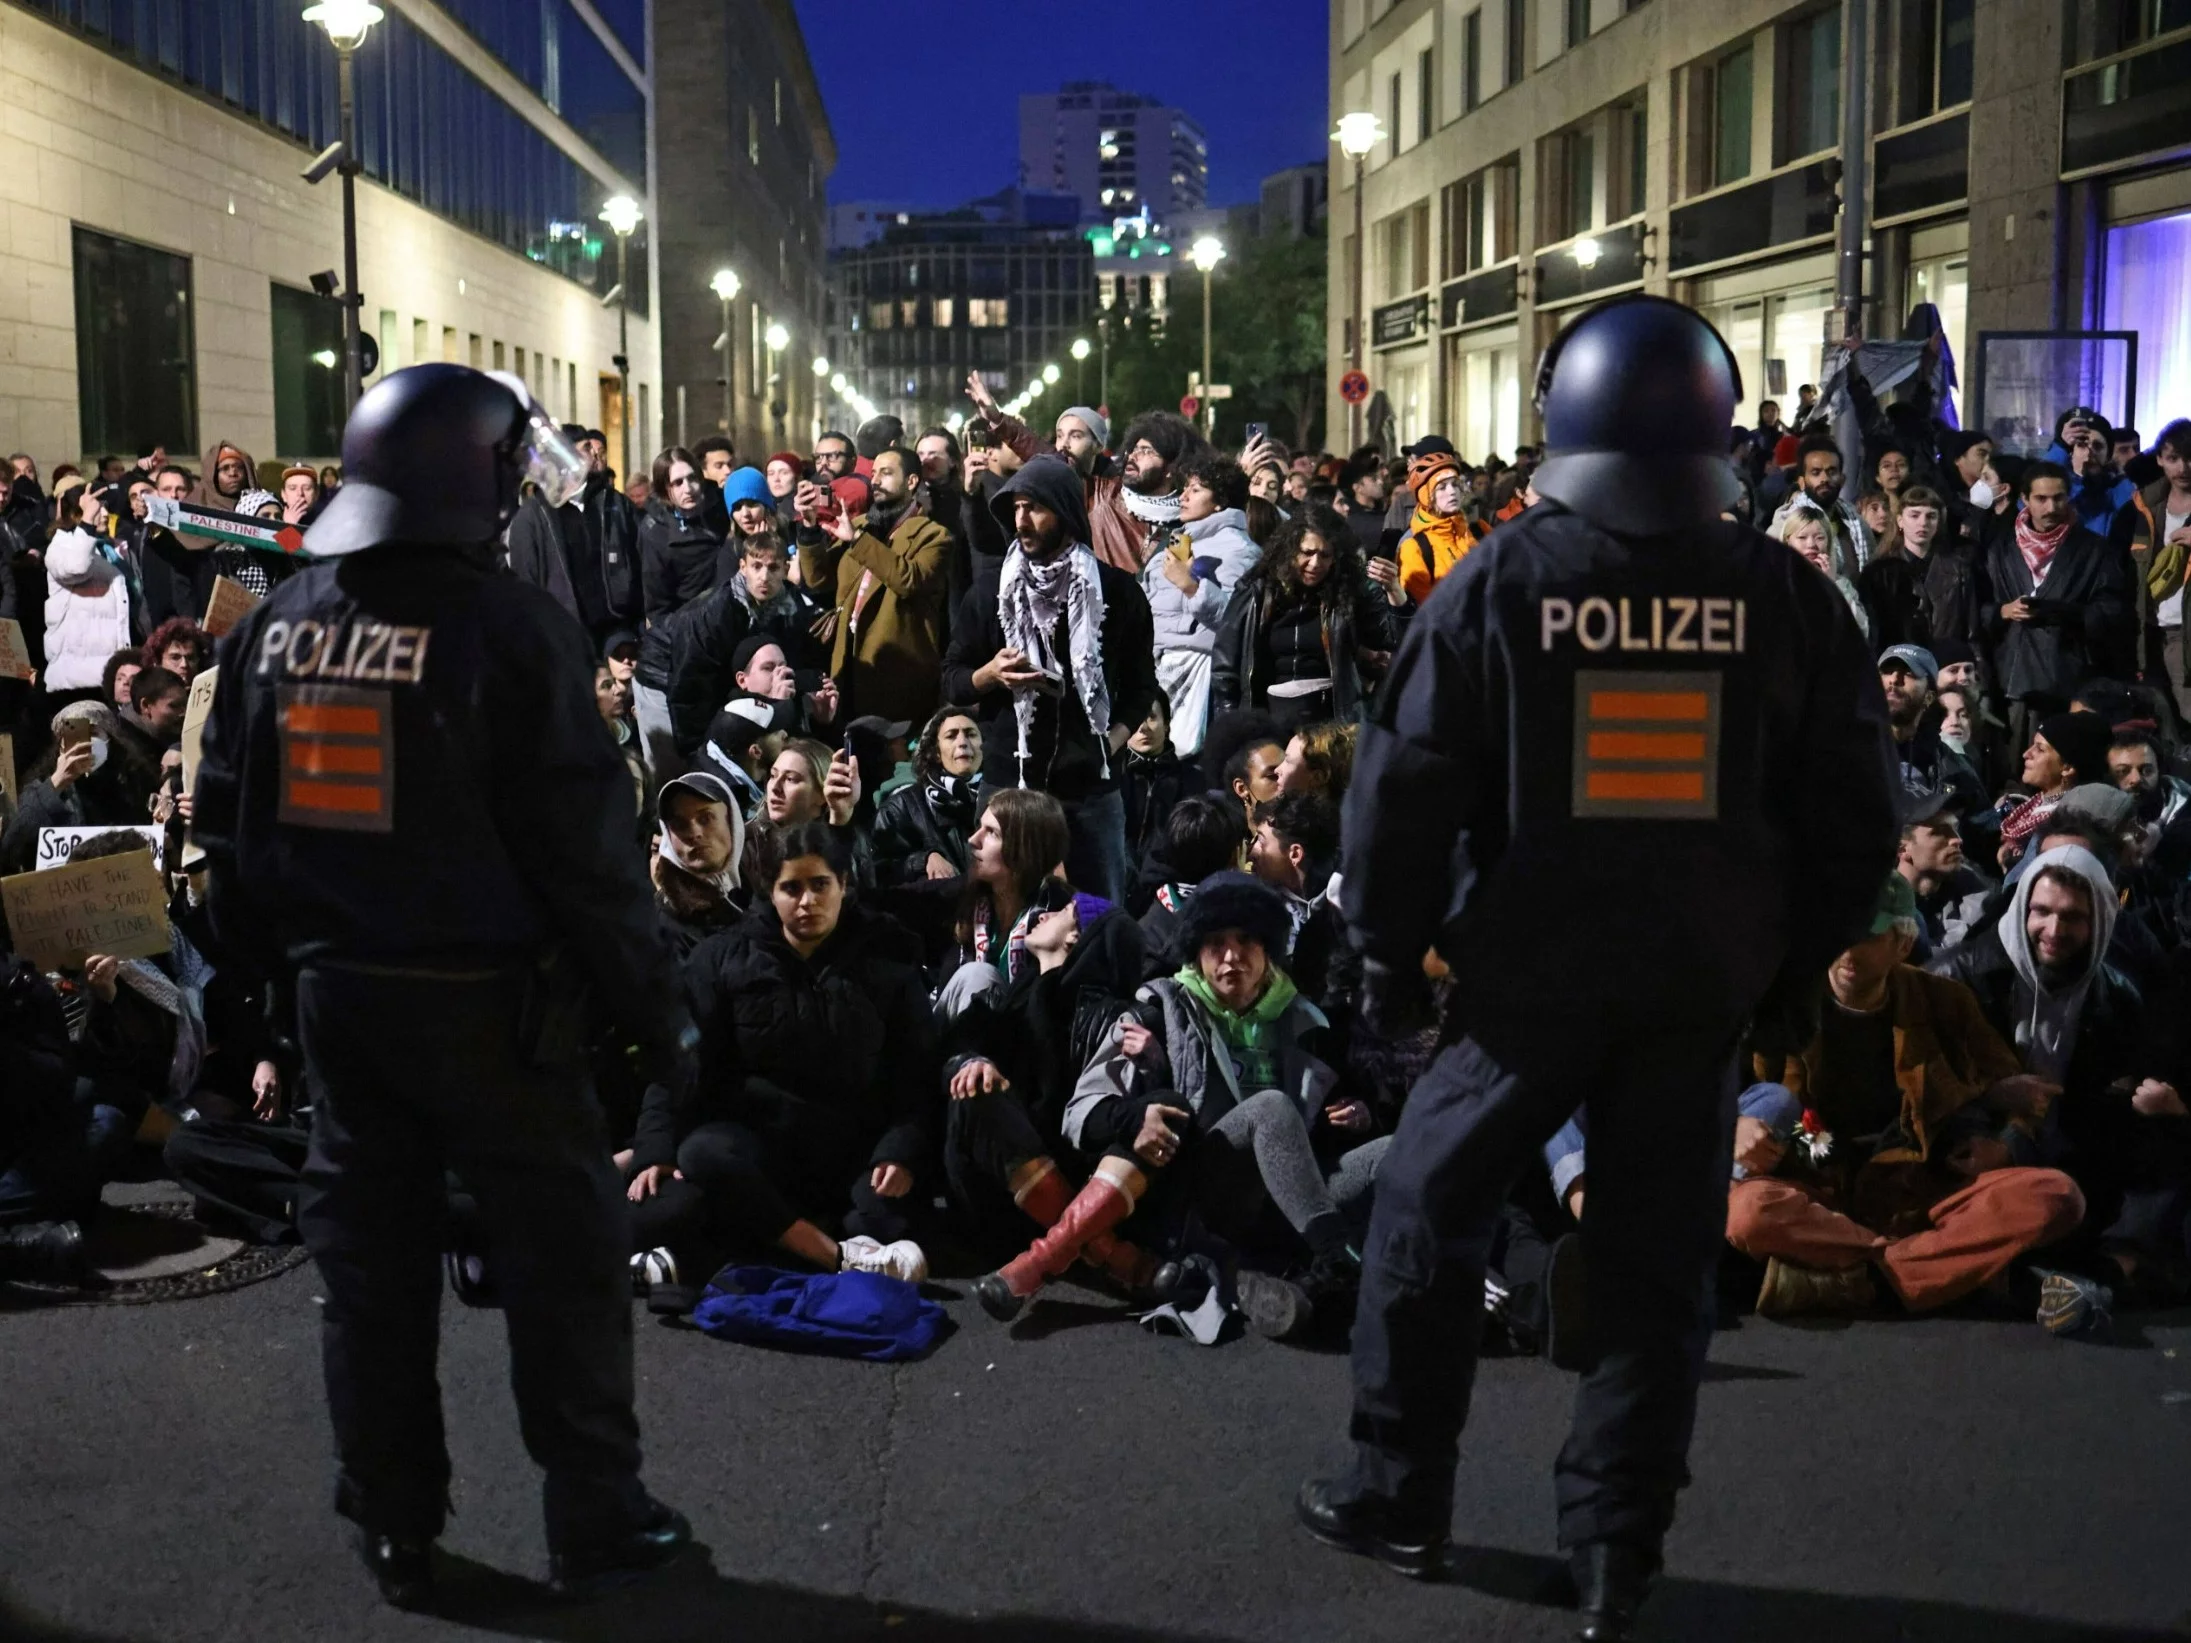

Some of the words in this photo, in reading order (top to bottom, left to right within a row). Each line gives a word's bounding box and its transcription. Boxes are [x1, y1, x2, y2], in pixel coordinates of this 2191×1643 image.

[190, 514, 261, 537] PALESTINE
[1541, 597, 1746, 652] POLIZEI
[257, 620, 432, 682] POLIZEI
[48, 873, 94, 899] HAVE
[105, 869, 132, 885] THE
[16, 905, 69, 932] RIGHT
[105, 889, 151, 912] STAND
